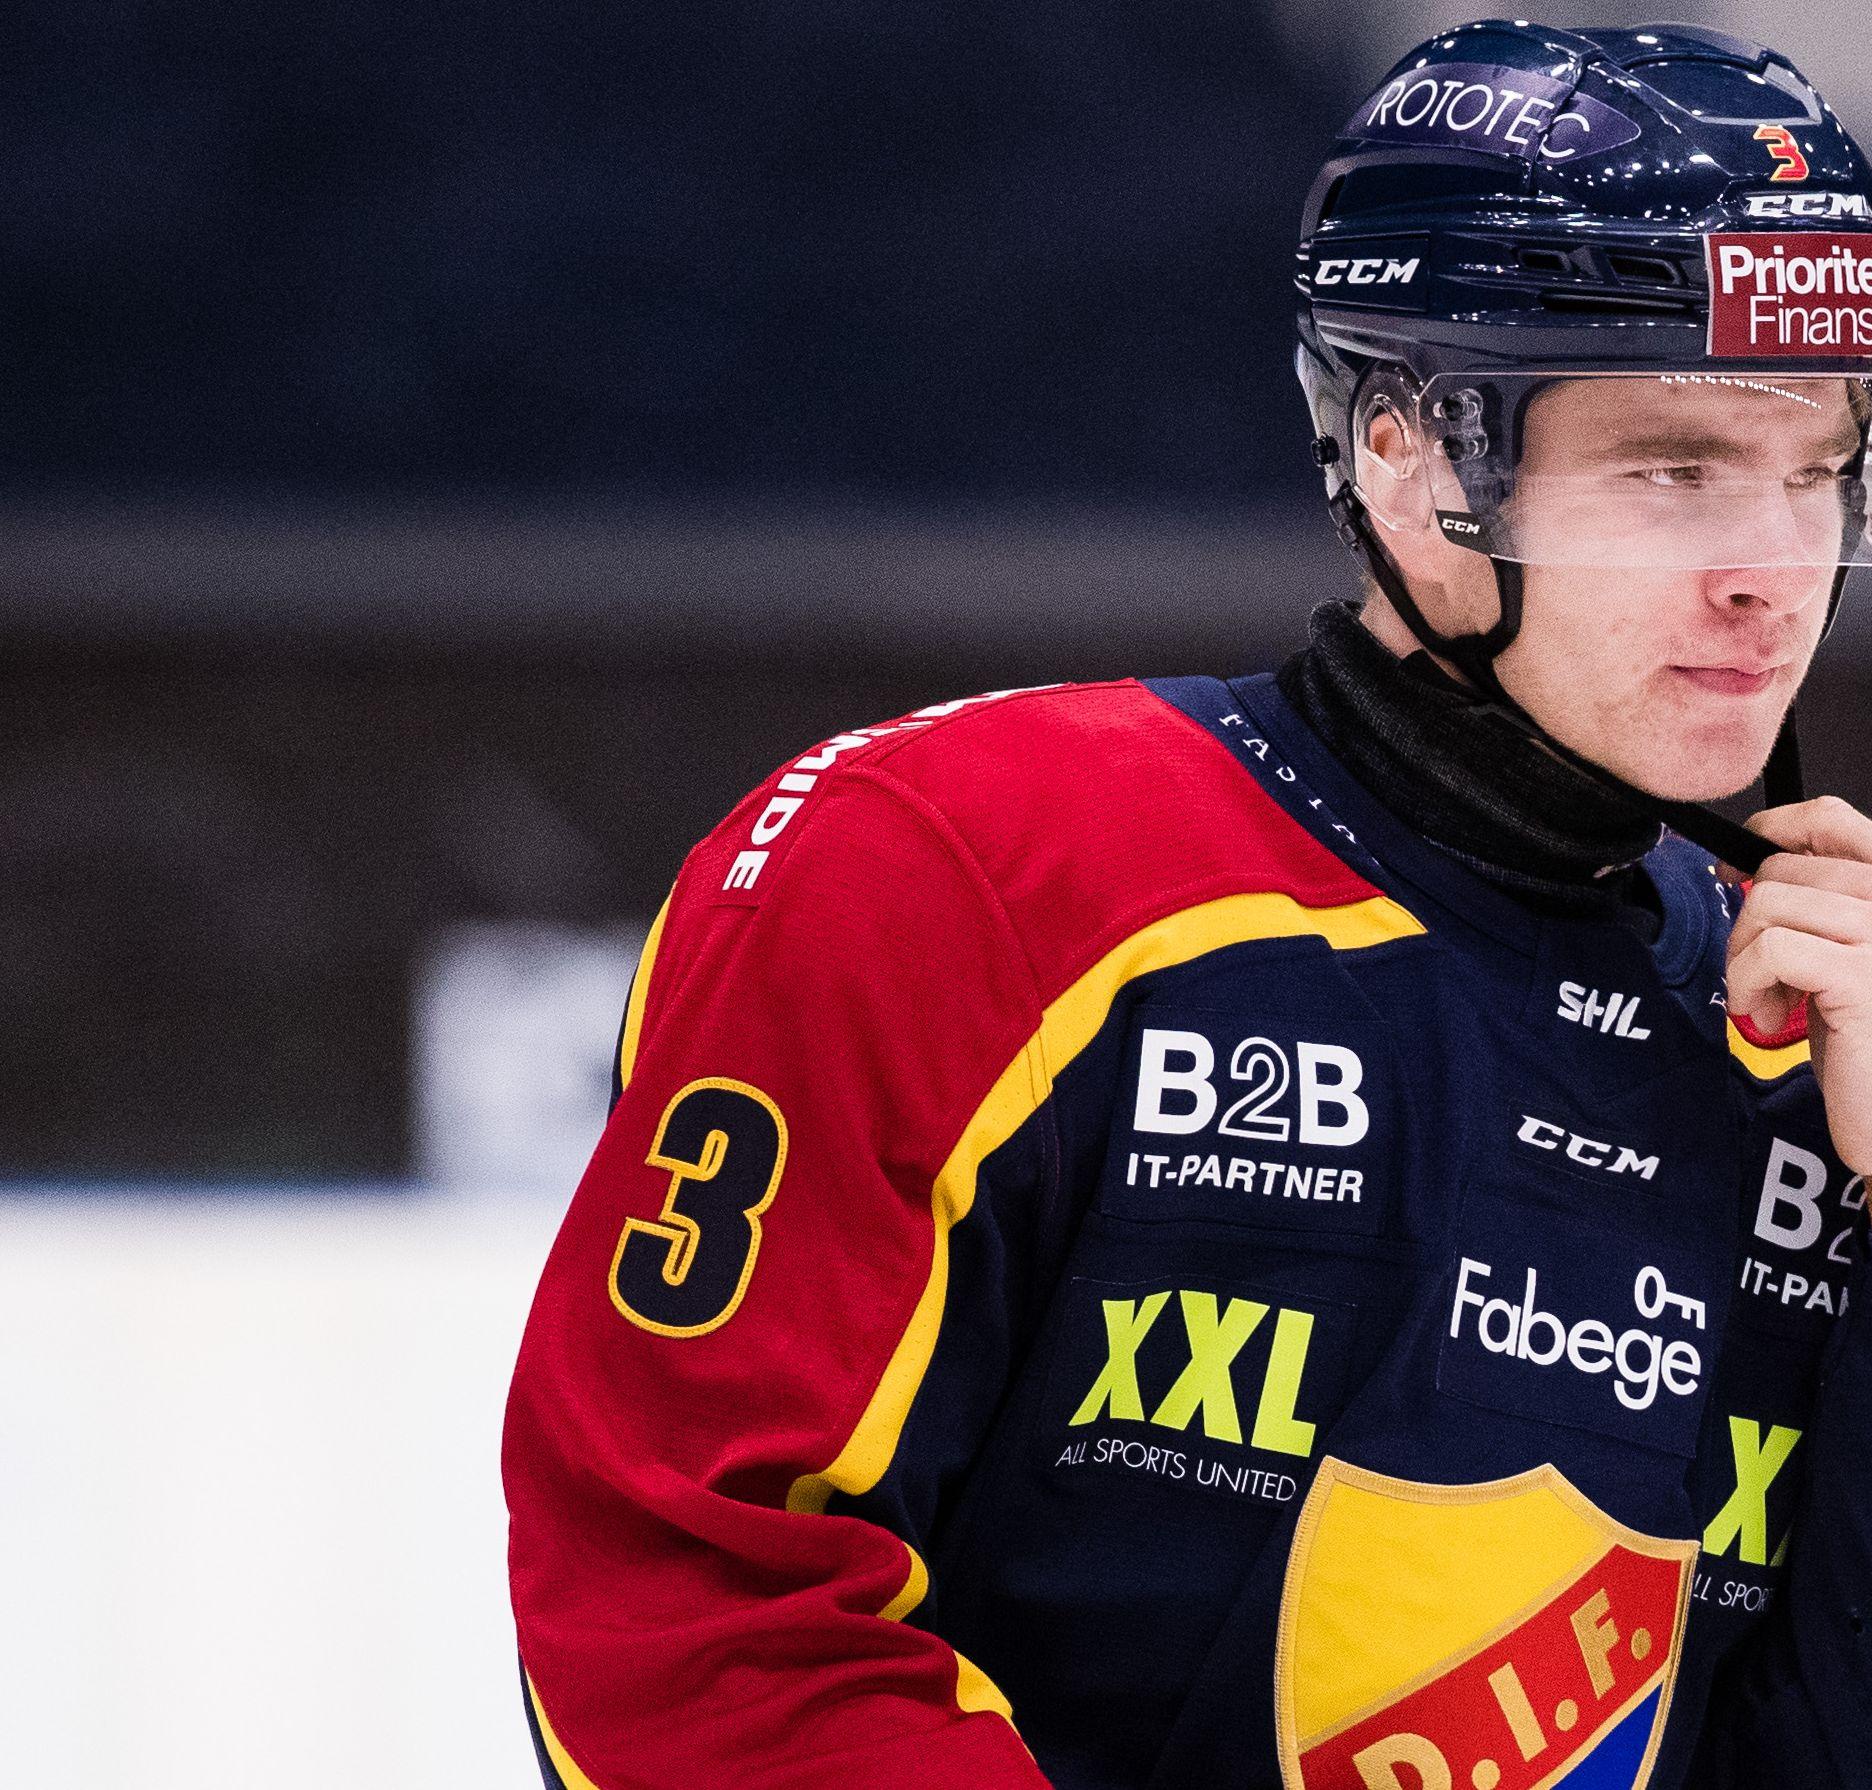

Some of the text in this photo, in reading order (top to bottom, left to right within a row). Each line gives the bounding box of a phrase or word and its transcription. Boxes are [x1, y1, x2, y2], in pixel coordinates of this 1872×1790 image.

[1366, 78, 1590, 159] ROTOTEC
[1752, 124, 1809, 182] 3
[1745, 193, 1869, 218] CCM
[1314, 257, 1421, 286] CCM
[1441, 517, 1481, 536] CCM
[1556, 981, 1651, 1040] SHL
[1133, 1028, 1369, 1147] B2B
[1126, 1152, 1364, 1203] IT-PARTNER
[1516, 1114, 1660, 1181] CCM
[608, 1076, 789, 1339] 3
[1450, 1257, 1702, 1410] Fabege
[1068, 1289, 1317, 1458] XXL
[1055, 1438, 1297, 1502] ALL SPORTS UNITED
[1718, 1581, 1771, 1612] SPOR
